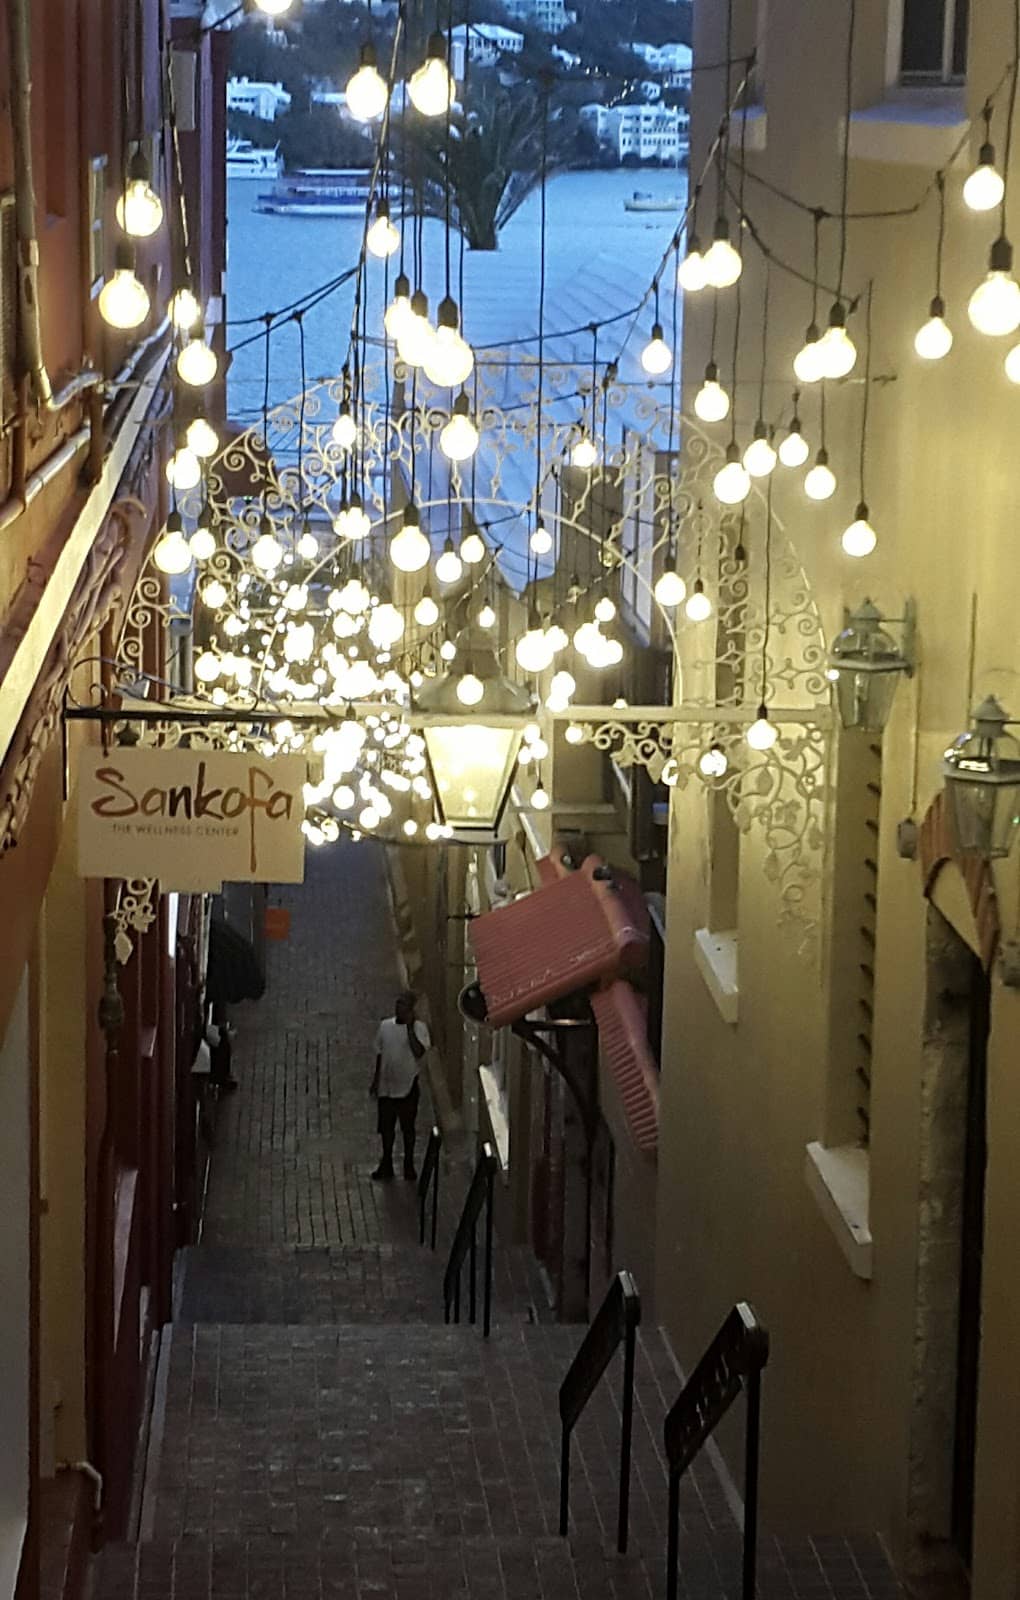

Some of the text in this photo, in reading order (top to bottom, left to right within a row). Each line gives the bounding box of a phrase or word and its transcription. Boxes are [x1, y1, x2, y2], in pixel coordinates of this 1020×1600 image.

[91, 761, 293, 873] Sankofa
[112, 823, 239, 838] THE WELLNESS CENTER
